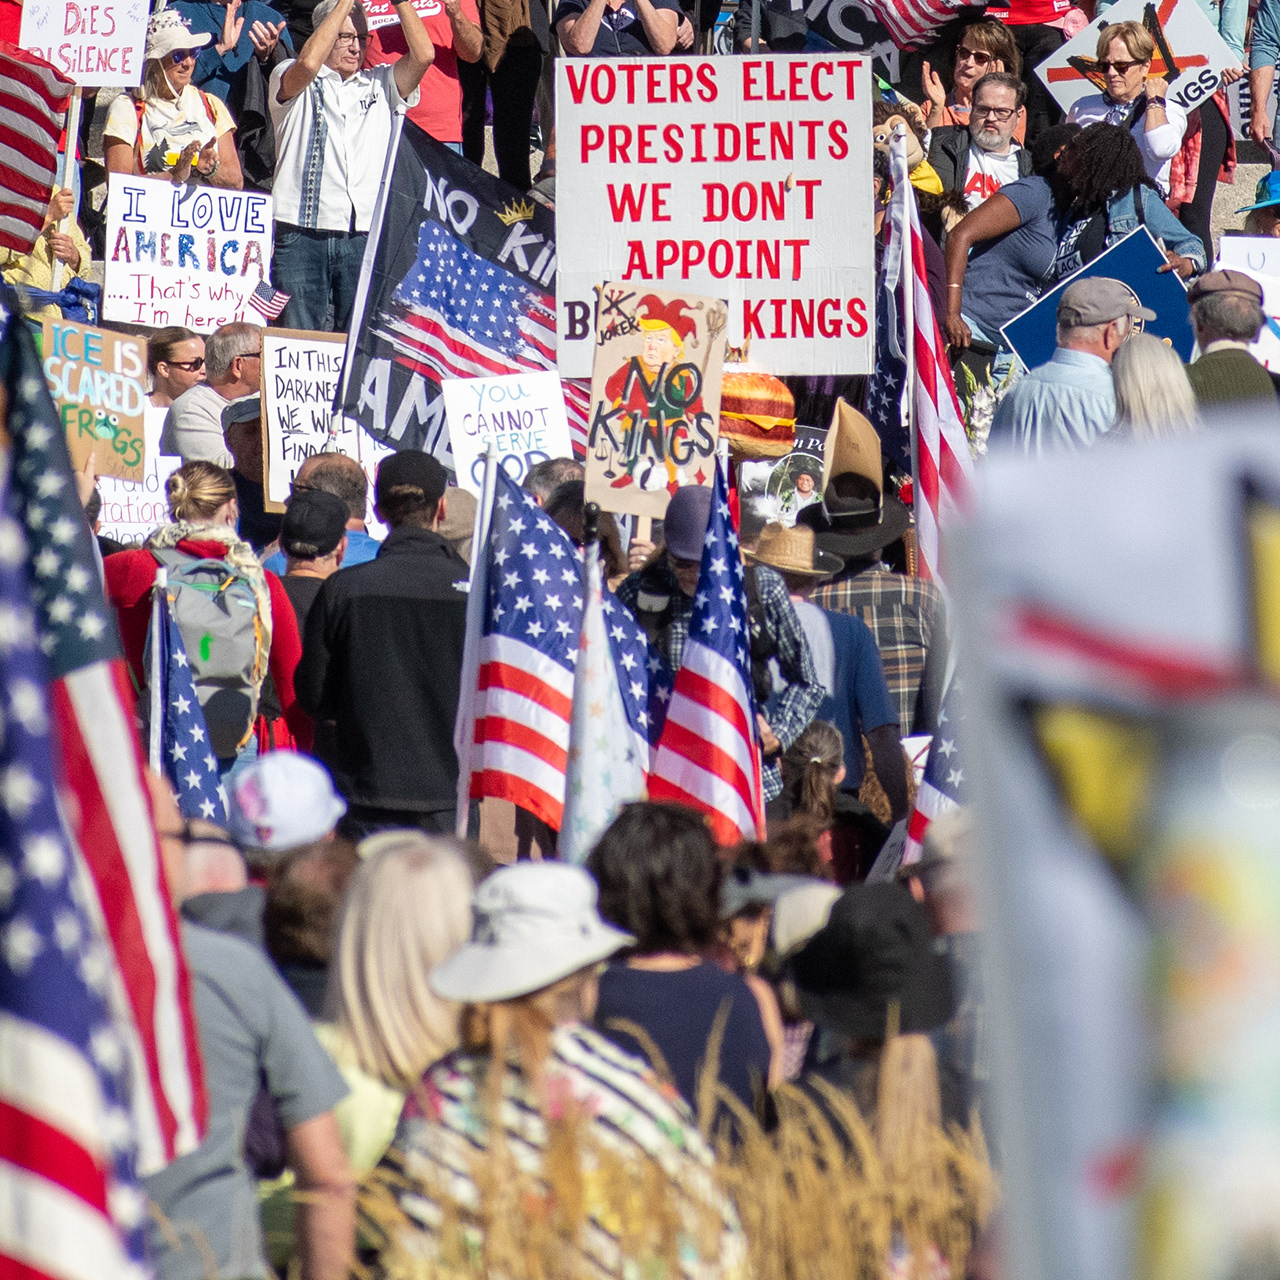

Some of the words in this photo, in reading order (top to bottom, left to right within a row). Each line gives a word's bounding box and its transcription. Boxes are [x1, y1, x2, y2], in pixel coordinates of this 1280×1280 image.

[565, 62, 719, 105] VOTERS
[742, 60, 863, 102] ELECT
[580, 119, 849, 164] PRESIDENTS
[122, 186, 148, 223] I
[171, 191, 267, 234] LOVE
[606, 181, 672, 223] WE
[111, 227, 264, 278] AMERICA
[622, 239, 810, 281] APPOINT
[130, 301, 169, 325] I'm
[209, 282, 244, 310] why
[596, 316, 640, 347] JOKER
[743, 297, 869, 340] KINGS
[51, 323, 103, 365] ICE
[113, 340, 143, 378] IS
[43, 356, 145, 417] SCARED
[627, 361, 703, 409] NO
[278, 406, 304, 434] WE
[463, 407, 548, 436] CANNOT
[589, 399, 715, 467] KINGS
